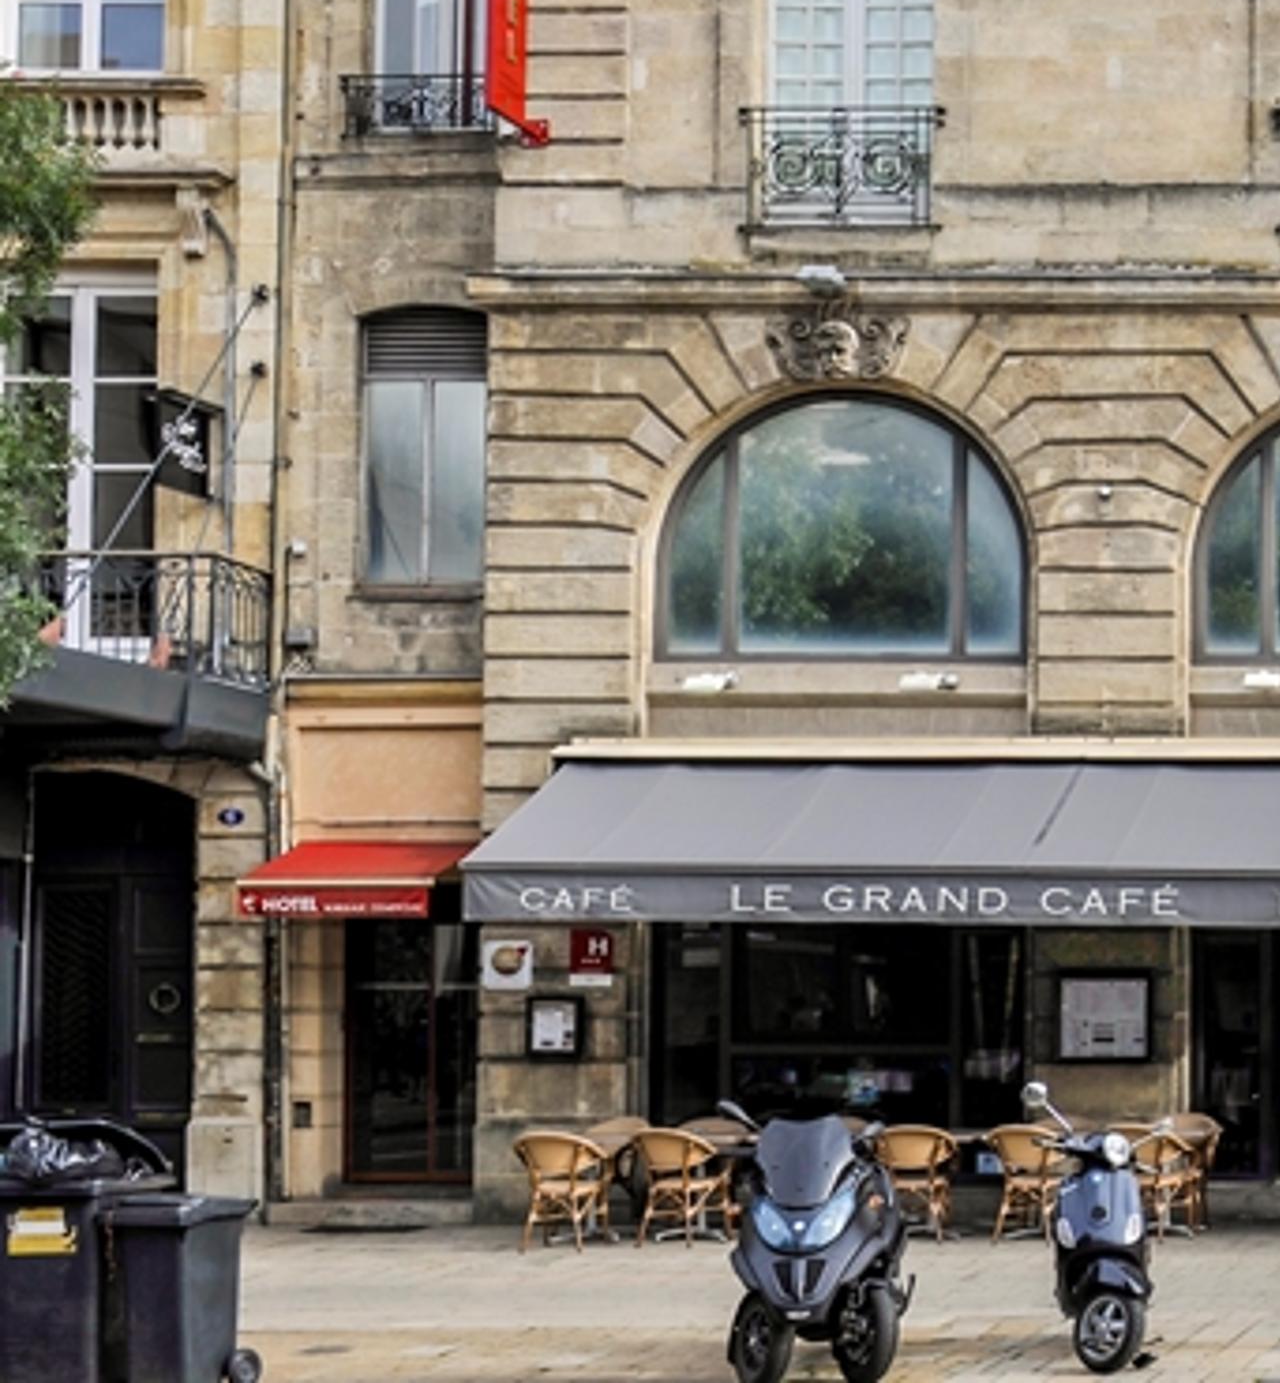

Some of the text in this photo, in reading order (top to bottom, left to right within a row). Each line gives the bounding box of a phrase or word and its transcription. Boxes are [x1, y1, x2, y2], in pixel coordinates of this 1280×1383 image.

[519, 884, 635, 912] CAFÉ
[730, 884, 1180, 916] LE GRAND CAFÉ
[588, 937, 609, 956] H
